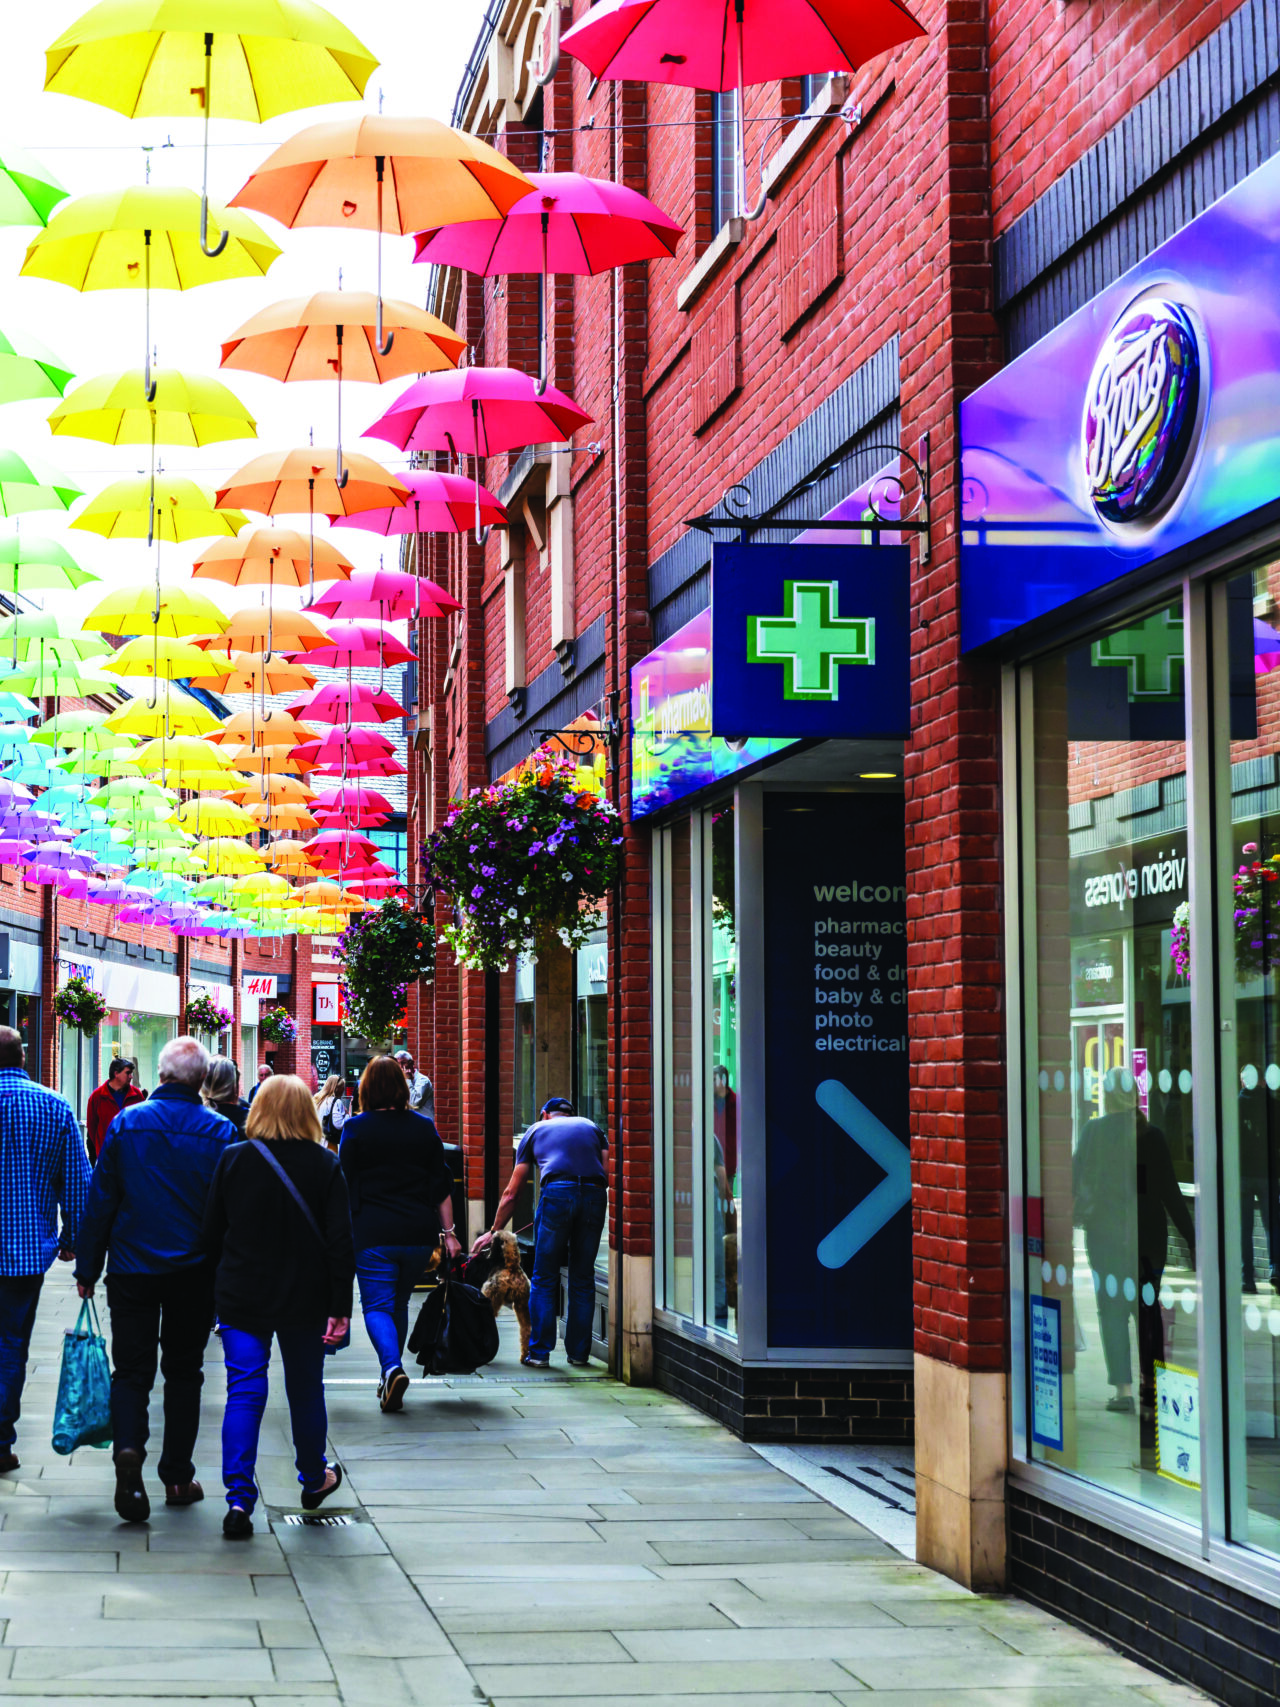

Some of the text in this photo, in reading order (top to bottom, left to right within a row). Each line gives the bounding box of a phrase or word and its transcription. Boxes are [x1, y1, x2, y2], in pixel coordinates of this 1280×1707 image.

[1090, 321, 1168, 496] Boots
[661, 680, 711, 745] pharmacy
[814, 940, 882, 961] beauty
[814, 964, 860, 981] food
[867, 964, 881, 981] &
[248, 978, 272, 995] H&M
[815, 987, 863, 1007] baby
[870, 987, 883, 1005] &
[815, 1010, 873, 1030] photo
[815, 1034, 906, 1051] electrical
